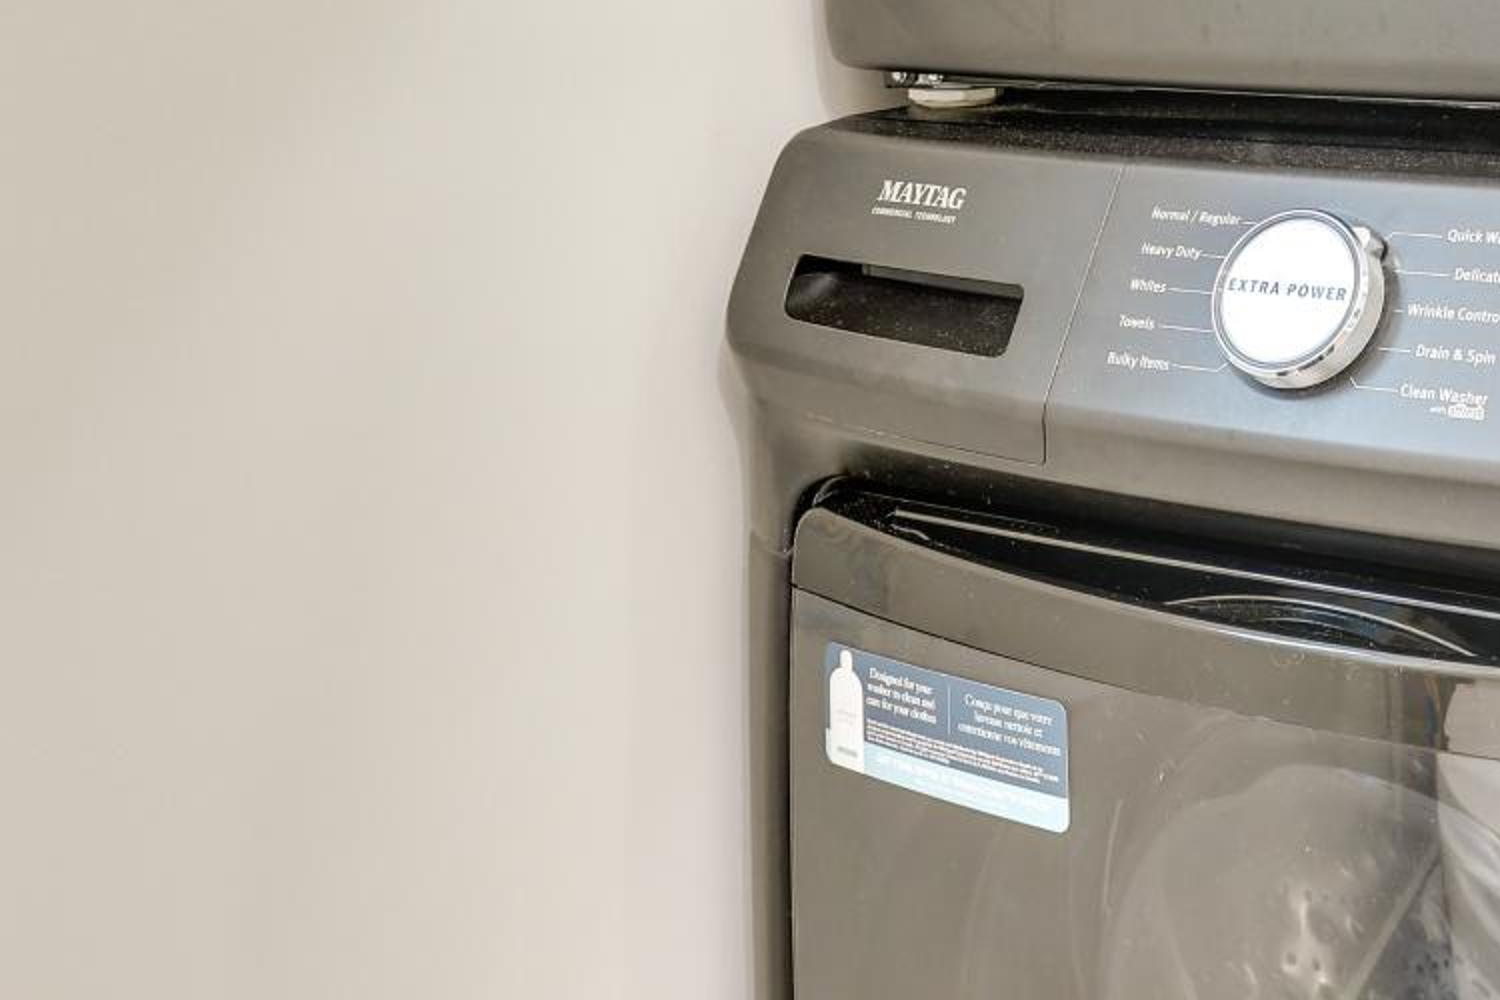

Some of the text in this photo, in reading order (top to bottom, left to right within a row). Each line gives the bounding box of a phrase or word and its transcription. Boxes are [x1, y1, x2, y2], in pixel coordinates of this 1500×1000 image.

[876, 180, 967, 209] MAYTAG
[1151, 207, 1191, 223] Normal
[1199, 210, 1241, 228] Regular
[1447, 229, 1484, 244] Quick
[1141, 242, 1202, 261] Heavy Duty
[1131, 279, 1167, 294] Whites
[1227, 277, 1348, 301] EXTRA POWER
[1119, 314, 1155, 329] Towels
[1407, 303, 1454, 321] Wrinkle
[1107, 351, 1170, 371] Bulky Items
[1415, 344, 1496, 367] Drain & Spin
[1400, 384, 1489, 405] Clean Washer
